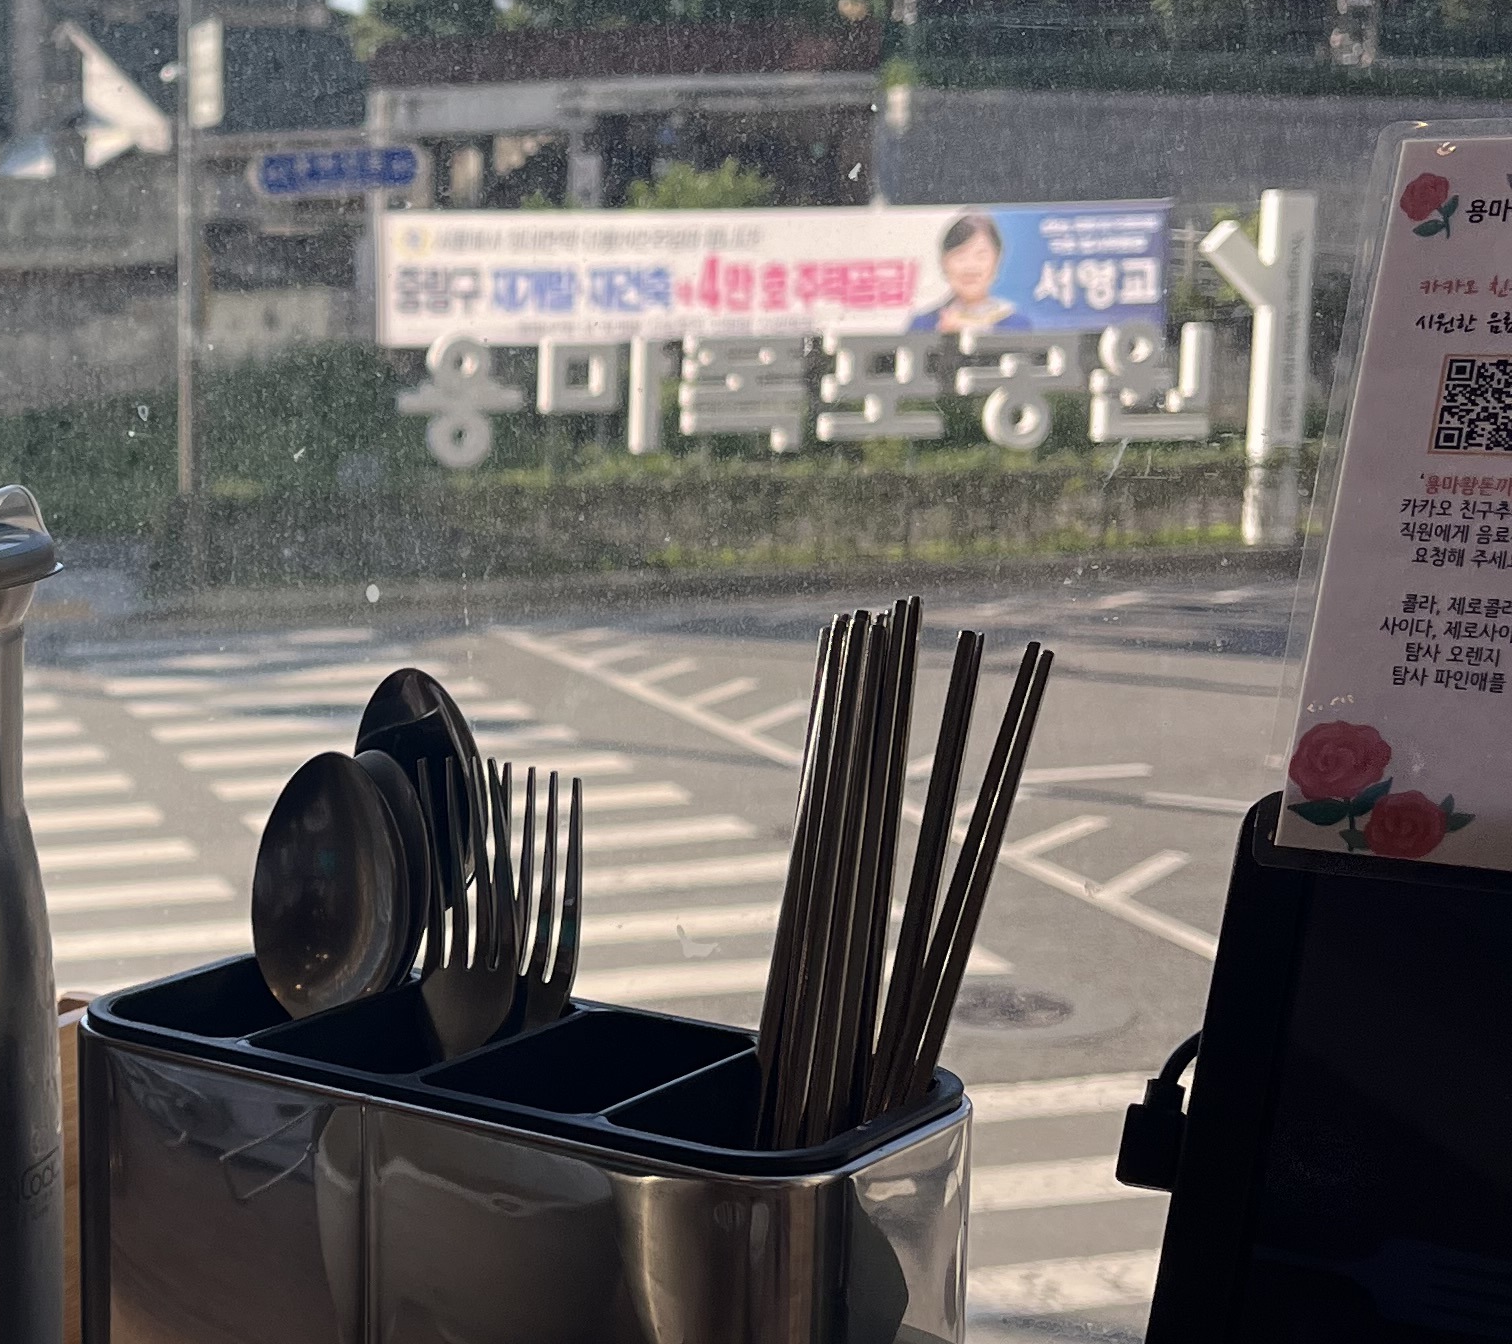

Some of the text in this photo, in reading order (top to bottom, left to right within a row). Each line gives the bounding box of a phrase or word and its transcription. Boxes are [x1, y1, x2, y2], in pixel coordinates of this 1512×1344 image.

[1488, 274, 1512, 298] 친
[1415, 312, 1478, 334] 시원한
[397, 321, 1213, 469] 용마폭포공원
[1400, 498, 1512, 520] 카카오 친구추
[1400, 522, 1512, 545] 직원에게 음료
[1411, 546, 1465, 567] 요청해
[1402, 593, 1440, 616] 콜라,
[1380, 617, 1512, 643] 사이다, 제로사이
[1405, 642, 1501, 667] 탐사 오렌지
[1392, 666, 1506, 694] 탐사 파인애플
